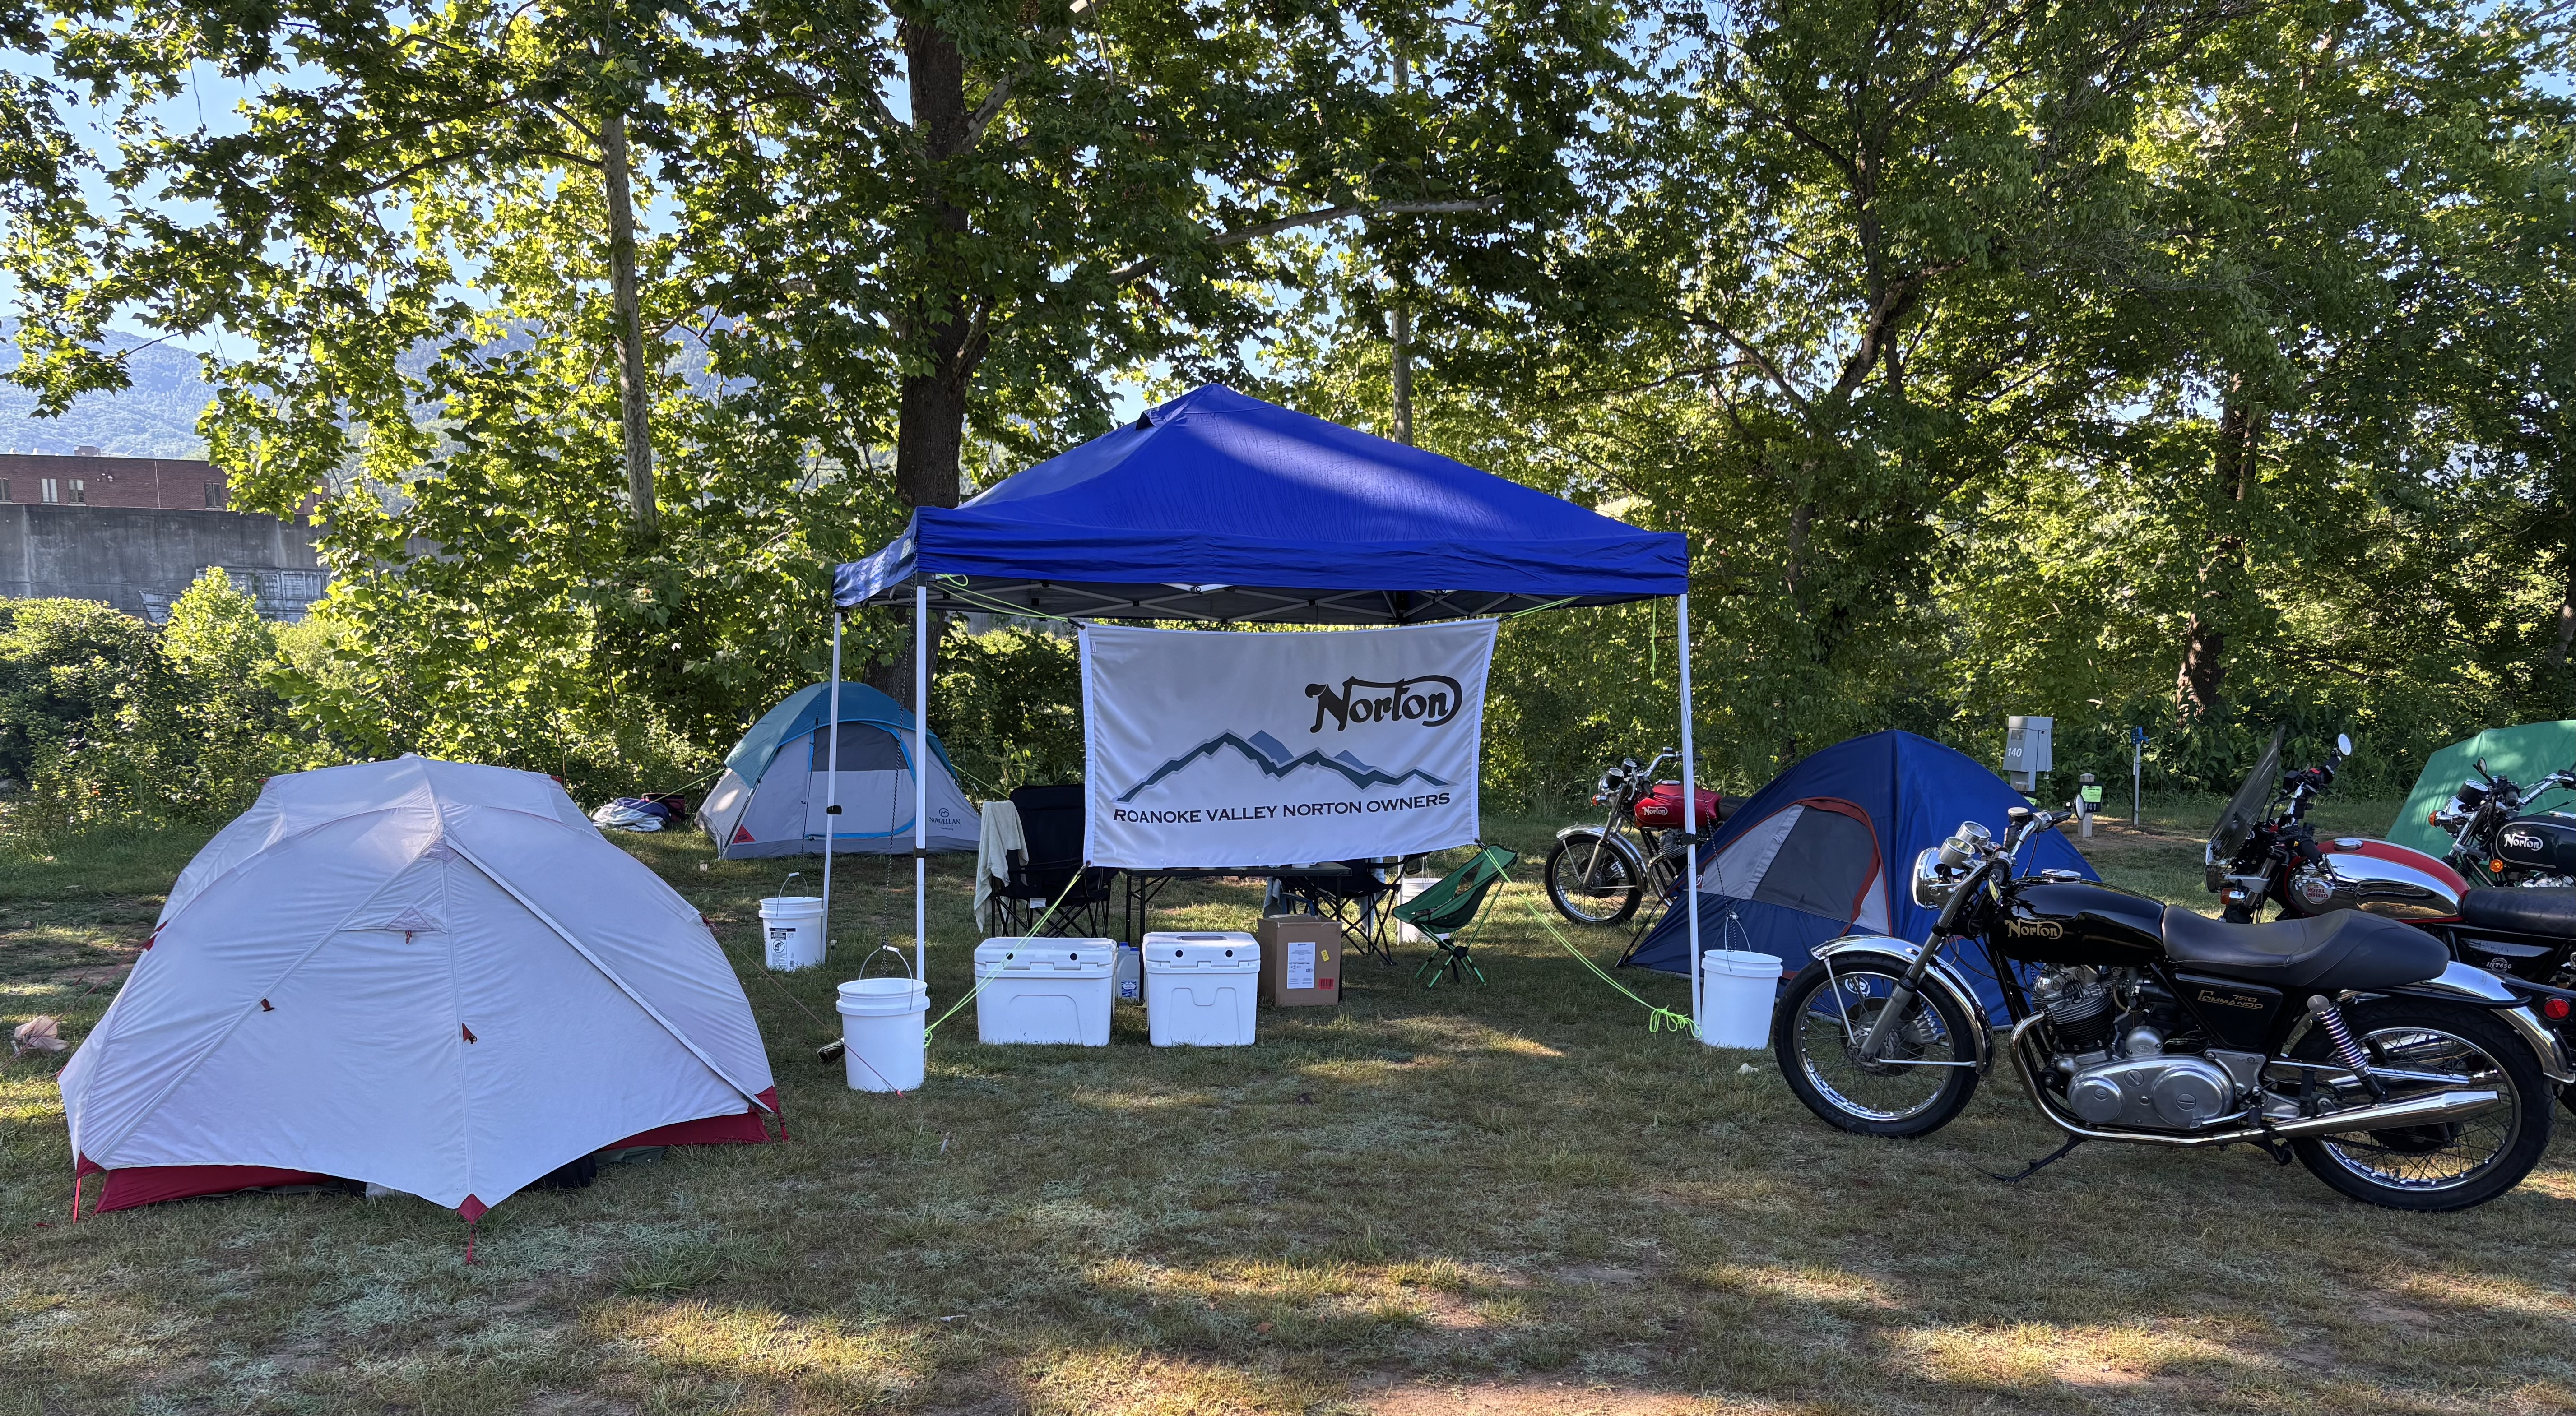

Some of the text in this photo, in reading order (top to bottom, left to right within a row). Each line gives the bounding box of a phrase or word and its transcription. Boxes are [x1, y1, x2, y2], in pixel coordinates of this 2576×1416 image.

[1305, 675, 1462, 733] Norton
[2008, 747, 2022, 757] 140
[1114, 792, 1450, 824] ROANOKE VALLEY NORTON OWNERS
[1642, 806, 1668, 816] Norton
[929, 817, 961, 825] MAGELLAN
[2504, 833, 2544, 851] Norton
[2004, 918, 2063, 939] Norton
[2197, 990, 2264, 1010] COMMANDO
